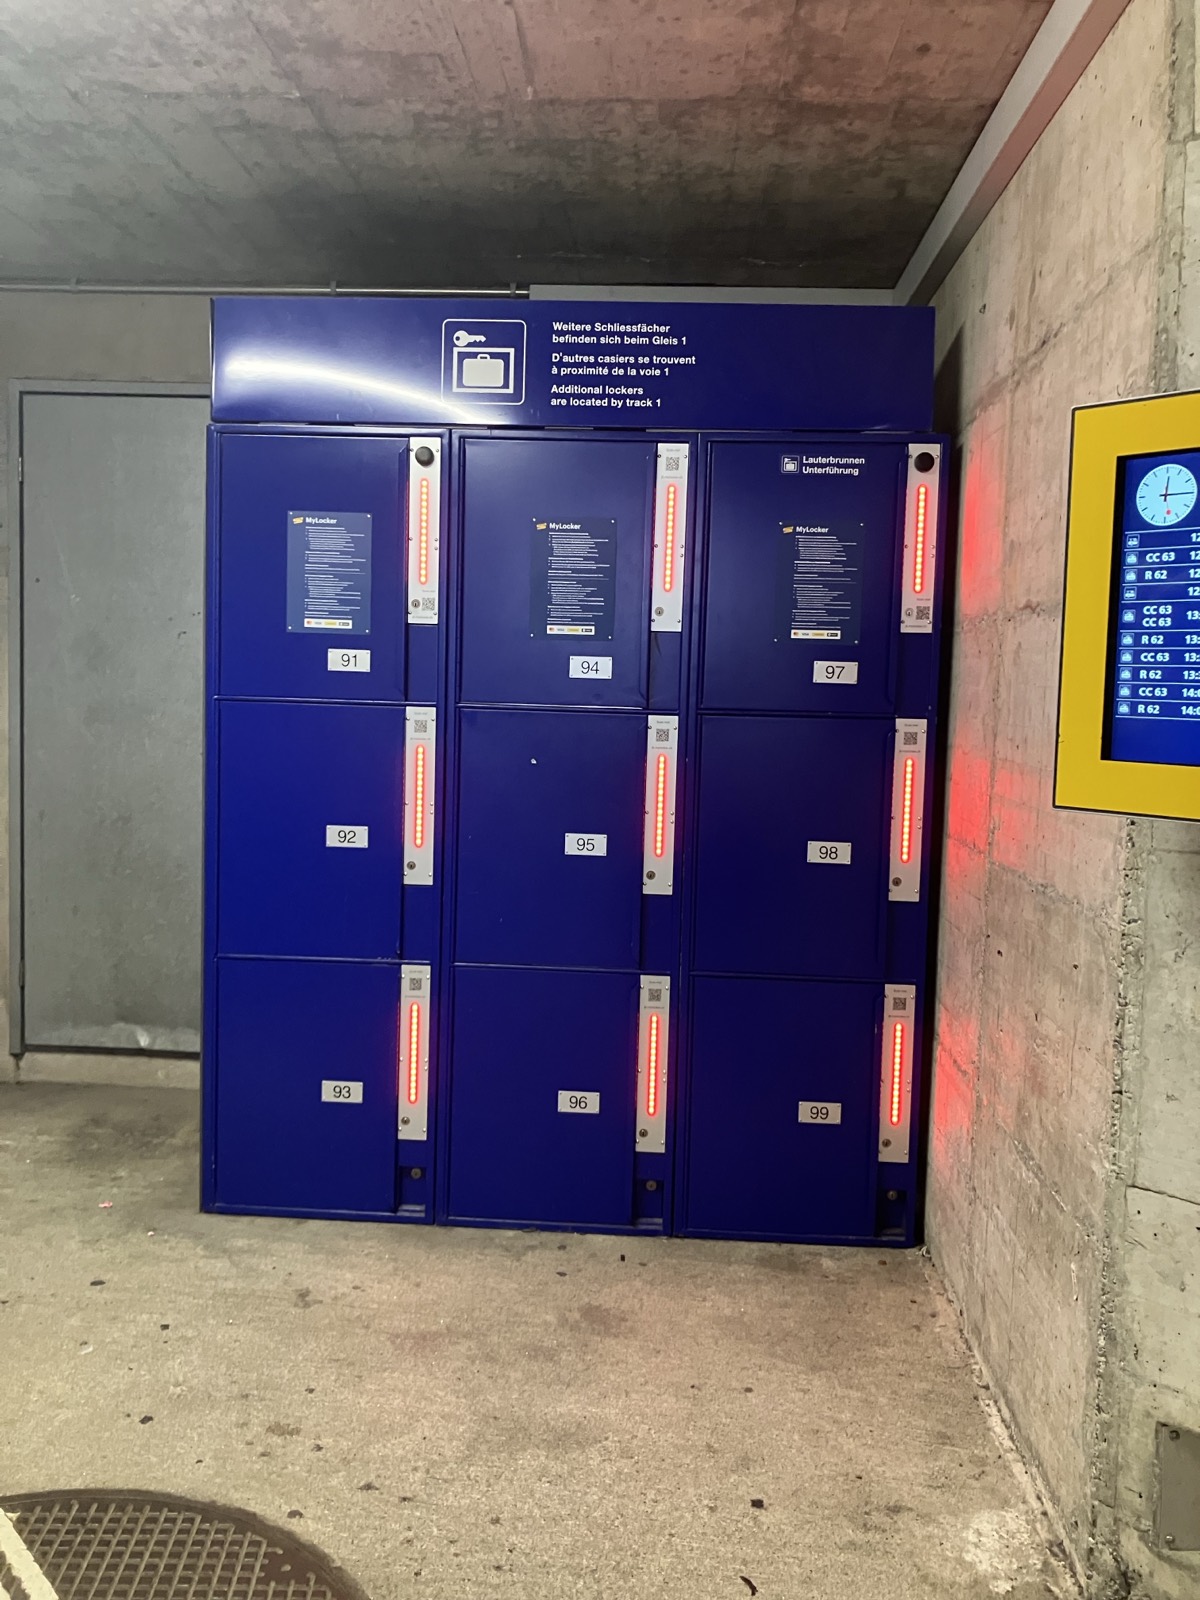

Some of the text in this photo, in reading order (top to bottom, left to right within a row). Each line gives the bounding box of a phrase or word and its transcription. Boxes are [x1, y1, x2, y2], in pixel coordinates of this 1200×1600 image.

[552, 322, 671, 332] Weitere Schliessfächer
[552, 334, 686, 345] befinden sich beim Gleis 1
[552, 352, 696, 364] D'autres casiers se trouvent
[551, 366, 669, 376] à proximité de la voie 1
[551, 385, 643, 395] Additional lockers
[570, 397, 608, 406] located
[611, 398, 623, 408] by
[626, 398, 652, 407] track
[656, 399, 661, 407] 1
[802, 456, 865, 464] Lauterbrunnen
[802, 466, 859, 476] Unterführung
[549, 522, 582, 530] MyLocker
[795, 526, 829, 534] MyLocker
[1146, 553, 1160, 562] CC
[1162, 552, 1175, 561] 63
[1145, 571, 1152, 580] R
[1154, 570, 1168, 579] 62
[1143, 605, 1172, 615] CC 63
[1142, 617, 1172, 627] CC 63
[1141, 635, 1149, 644] R
[1150, 635, 1164, 644] 62
[341, 653, 357, 667] 91
[1140, 652, 1155, 662] CC
[1156, 652, 1170, 662] 63
[581, 660, 600, 675] 94
[825, 665, 845, 680] 97
[1140, 670, 1147, 679] R
[1149, 670, 1162, 679] 62
[1138, 687, 1153, 696] CC
[1154, 688, 1168, 696] 63
[1138, 704, 1145, 714] R
[1147, 705, 1160, 714] 62
[338, 830, 356, 844] 92
[576, 838, 595, 852] 95
[819, 846, 838, 860] 98
[333, 1085, 351, 1099] 93
[569, 1096, 588, 1110] 96
[810, 1106, 829, 1120] 99
